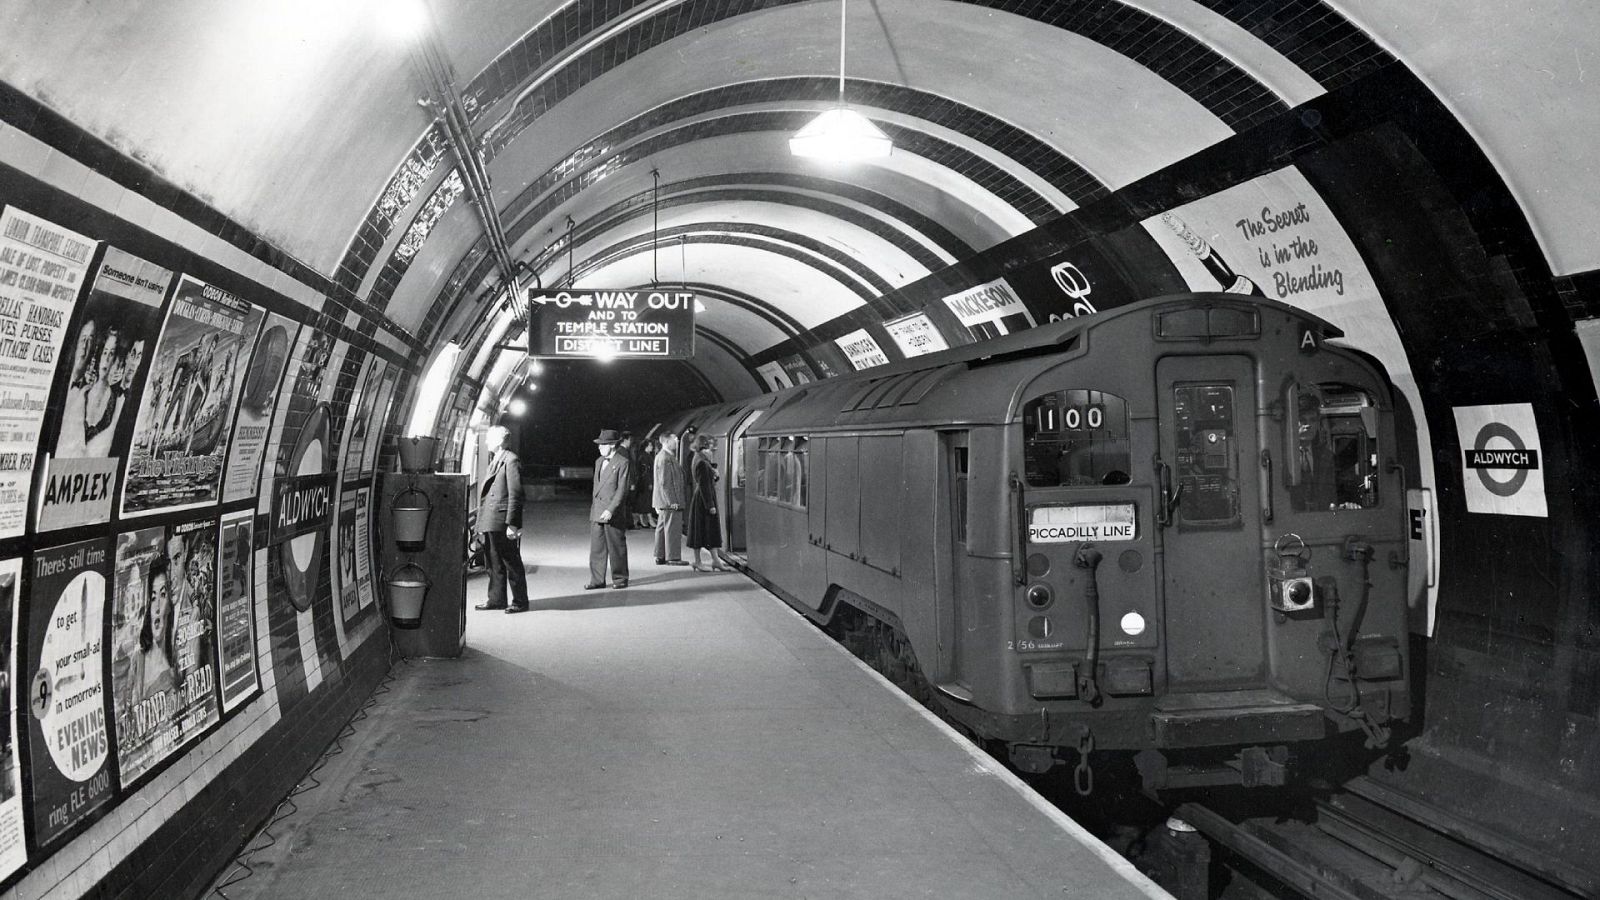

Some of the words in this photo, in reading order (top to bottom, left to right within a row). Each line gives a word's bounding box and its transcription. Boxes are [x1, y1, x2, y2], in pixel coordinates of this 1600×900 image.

[1236, 219, 1265, 241] The
[1262, 202, 1310, 232] Secret
[1258, 247, 1271, 268] is
[1273, 244, 1291, 264] in
[1290, 236, 1318, 259] the
[102, 264, 135, 283] Someone
[134, 276, 149, 290] isn't
[147, 281, 164, 294] using
[1273, 264, 1344, 298] Blending
[588, 311, 615, 320] AND
[621, 311, 637, 320] TO
[595, 292, 638, 309] WAY
[648, 293, 692, 309] OUT
[951, 284, 1015, 318] MACKESON
[557, 322, 608, 333] TEMPLE
[613, 323, 668, 334] STATION
[1301, 330, 1316, 348] A
[32, 345, 55, 363] CASES
[564, 340, 623, 351] DISTCT
[630, 341, 660, 351] LINE
[163, 450, 217, 480] Vikings
[1474, 452, 1529, 465] ALDWYCH
[44, 472, 112, 506] AMPLEX
[278, 486, 330, 528] ALDWYCH
[1030, 527, 1099, 539] PICCADILLY
[1104, 525, 1132, 537] LINE
[36, 556, 66, 578] There's
[69, 550, 85, 570] still
[86, 546, 105, 564] time
[56, 616, 64, 629] to
[65, 611, 78, 631] get
[55, 653, 71, 676] your
[73, 638, 101, 663] small-ad
[39, 680, 48, 709] 9
[55, 700, 62, 715] in
[64, 682, 101, 710] tomorrow's
[134, 691, 166, 738] WIND
[186, 664, 213, 704] READ
[57, 707, 104, 751] EVENING
[71, 730, 106, 772] NEWS
[49, 803, 69, 828] ring
[70, 786, 86, 813] FLE
[88, 770, 109, 798] 6000
